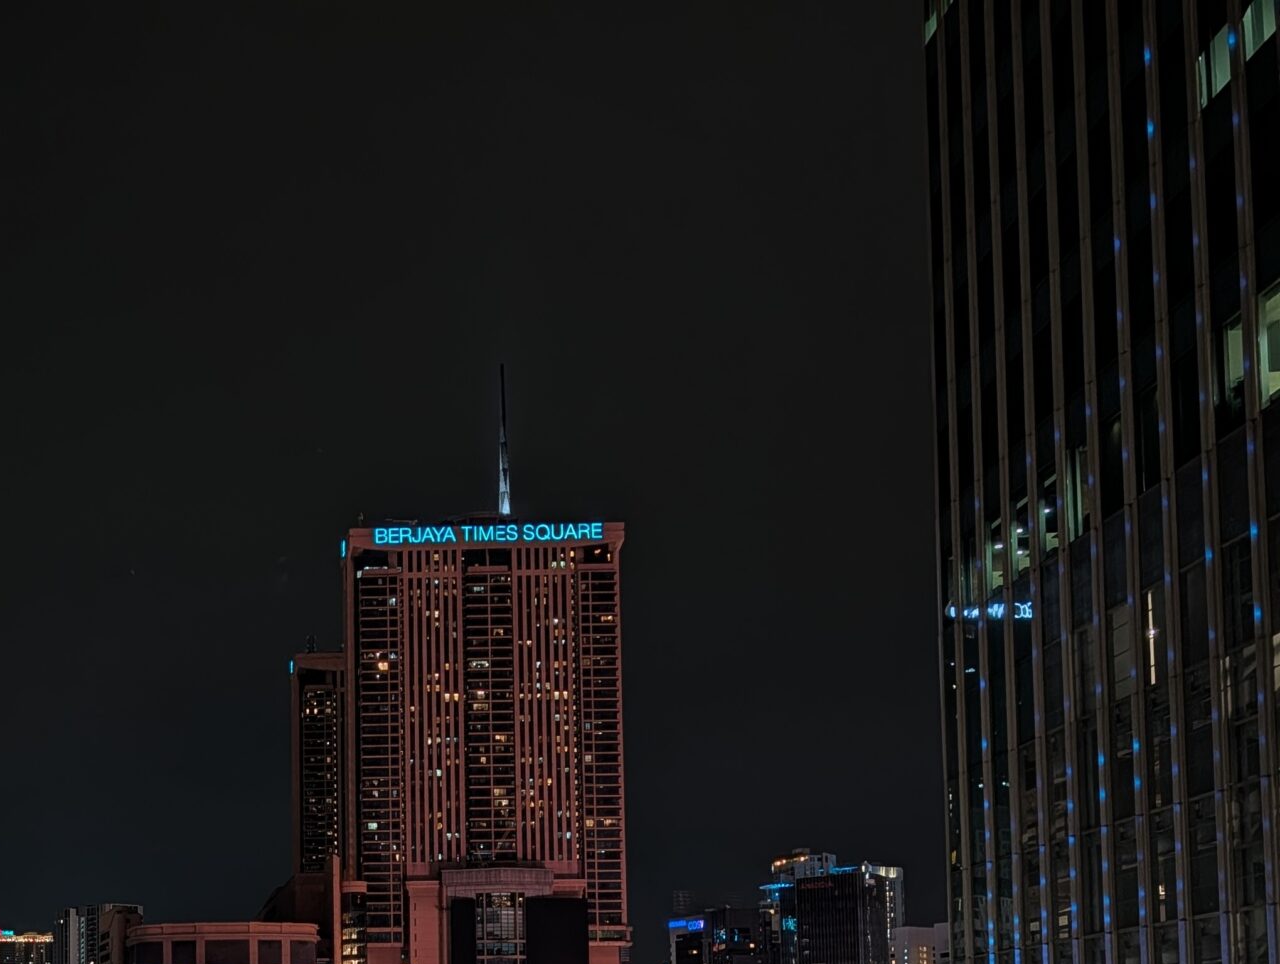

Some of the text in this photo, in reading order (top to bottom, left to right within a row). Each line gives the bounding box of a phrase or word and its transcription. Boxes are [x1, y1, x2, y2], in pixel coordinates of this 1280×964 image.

[375, 523, 602, 544] BERJAYA TIMES SQUARE
